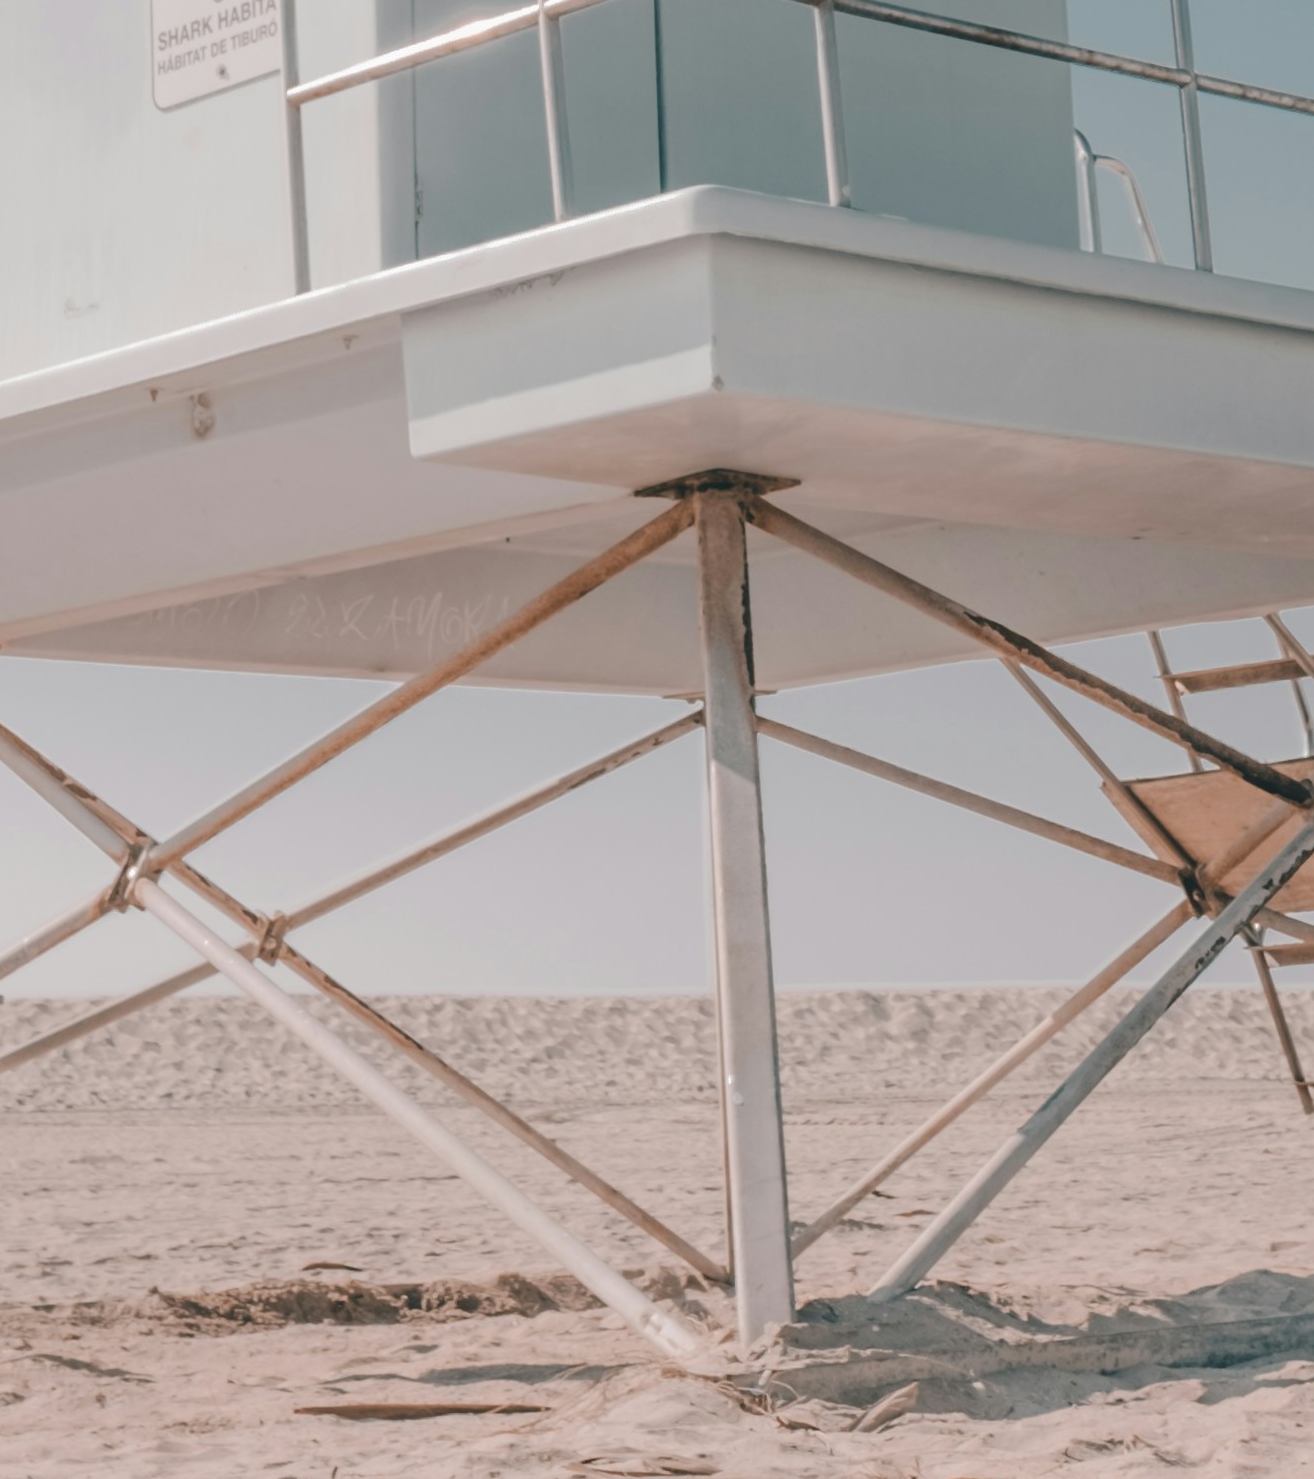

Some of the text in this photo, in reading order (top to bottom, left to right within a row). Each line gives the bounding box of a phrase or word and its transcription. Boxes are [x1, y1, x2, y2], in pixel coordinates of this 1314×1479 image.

[157, 15, 214, 52] SHARK
[157, 17, 278, 76] HÁBITAT DE TIBURÓ
